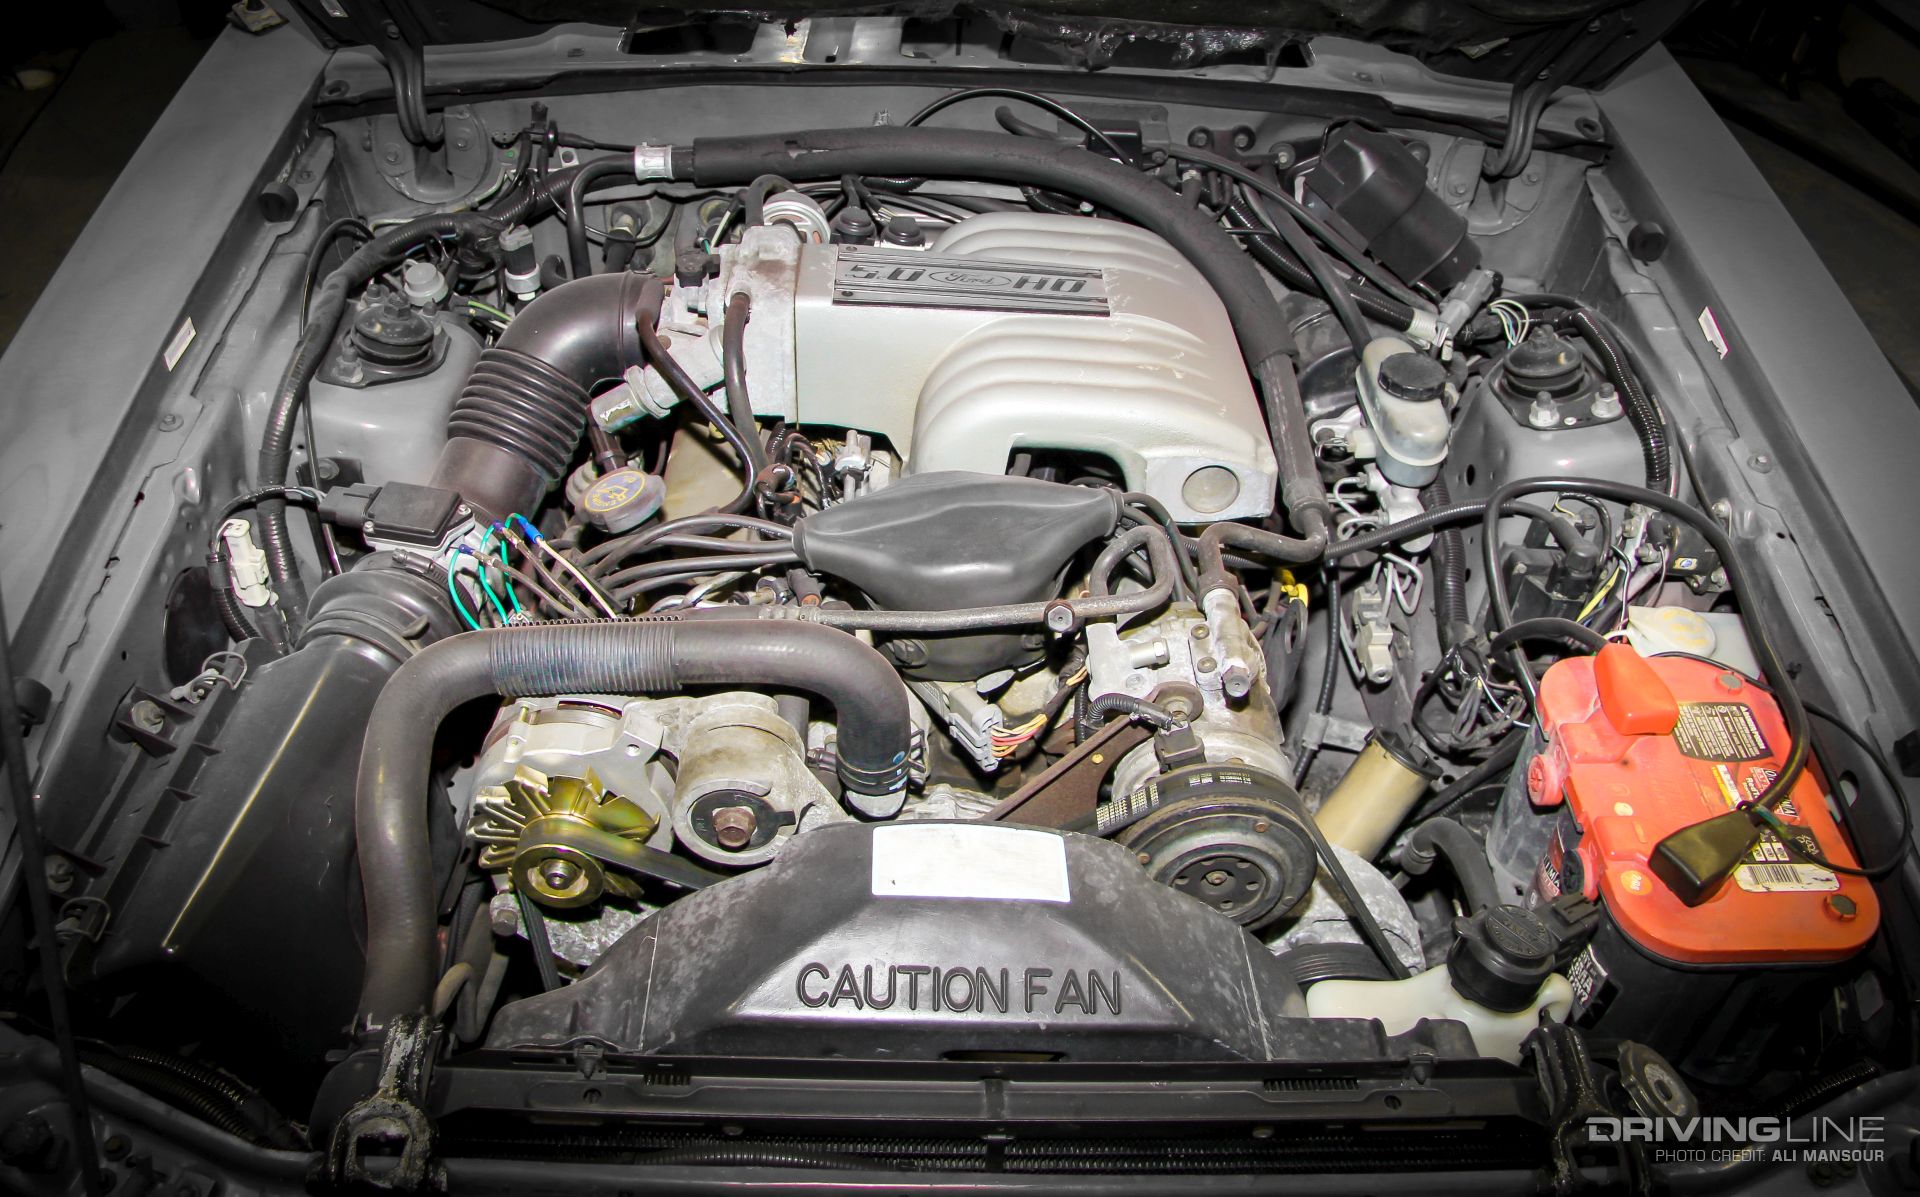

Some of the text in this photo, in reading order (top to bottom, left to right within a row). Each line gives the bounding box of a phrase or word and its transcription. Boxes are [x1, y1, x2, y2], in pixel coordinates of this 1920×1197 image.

[940, 269, 998, 286] Ford
[796, 962, 1122, 1016] CAUTION FAN
